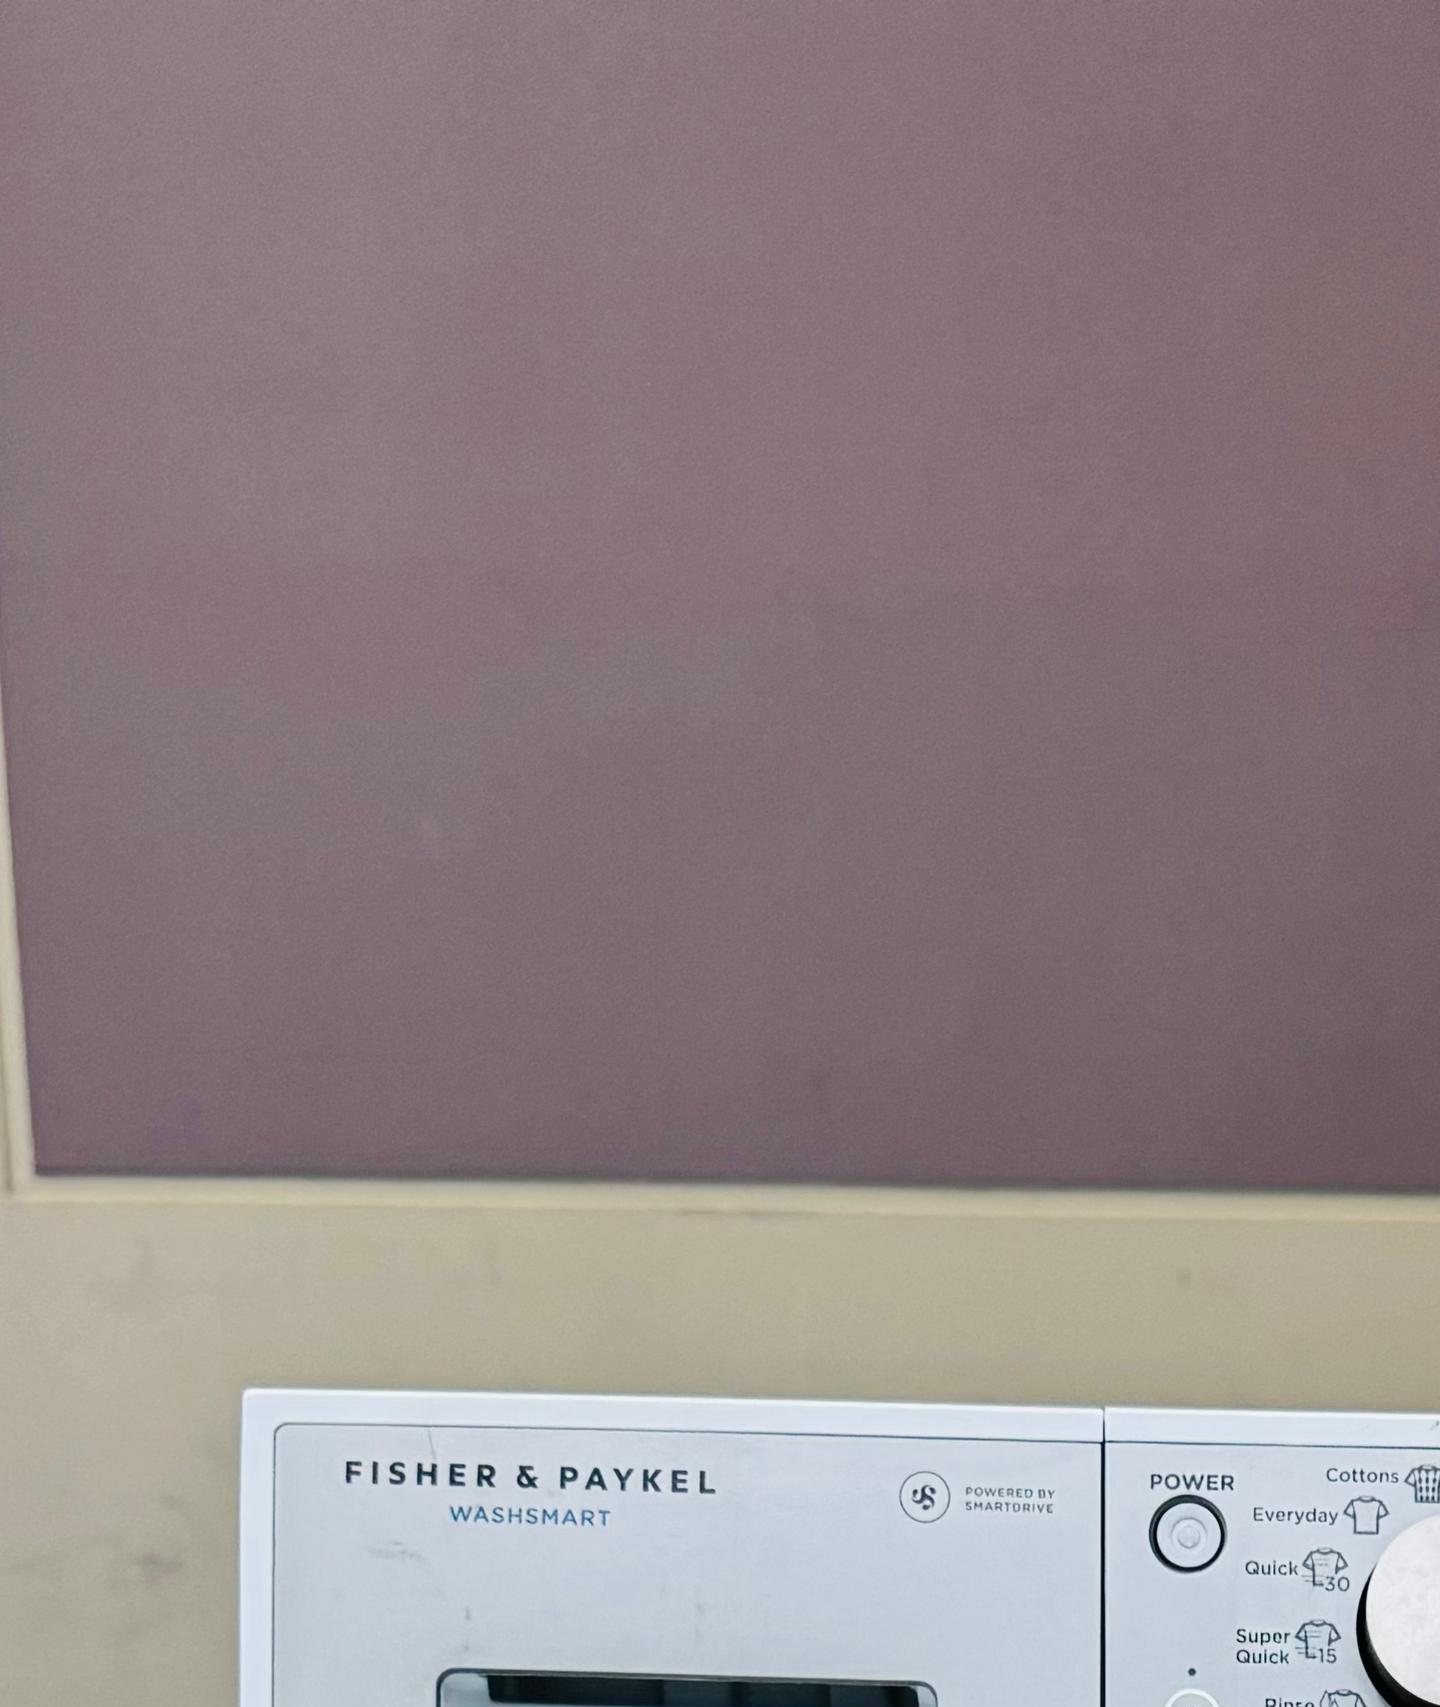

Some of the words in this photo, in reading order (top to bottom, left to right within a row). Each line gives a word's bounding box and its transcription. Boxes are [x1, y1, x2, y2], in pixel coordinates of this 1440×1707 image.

[345, 1460, 496, 1488] FISHER
[516, 1465, 539, 1489] &
[559, 1466, 716, 1495] PAYKEL
[1149, 1473, 1235, 1492] POWER
[1326, 1467, 1400, 1485] Cottons
[965, 1486, 1033, 1499] POWERED
[1038, 1489, 1055, 1499] BY
[965, 1501, 1054, 1514] SMARTDRIVE
[450, 1506, 611, 1527] WASHSMART
[1252, 1506, 1339, 1527] Everyday
[1244, 1560, 1299, 1577] Quick
[1324, 1576, 1351, 1592] 30
[1235, 1629, 1291, 1648] Super
[1235, 1648, 1290, 1665] Quick
[1317, 1649, 1337, 1664] 15
